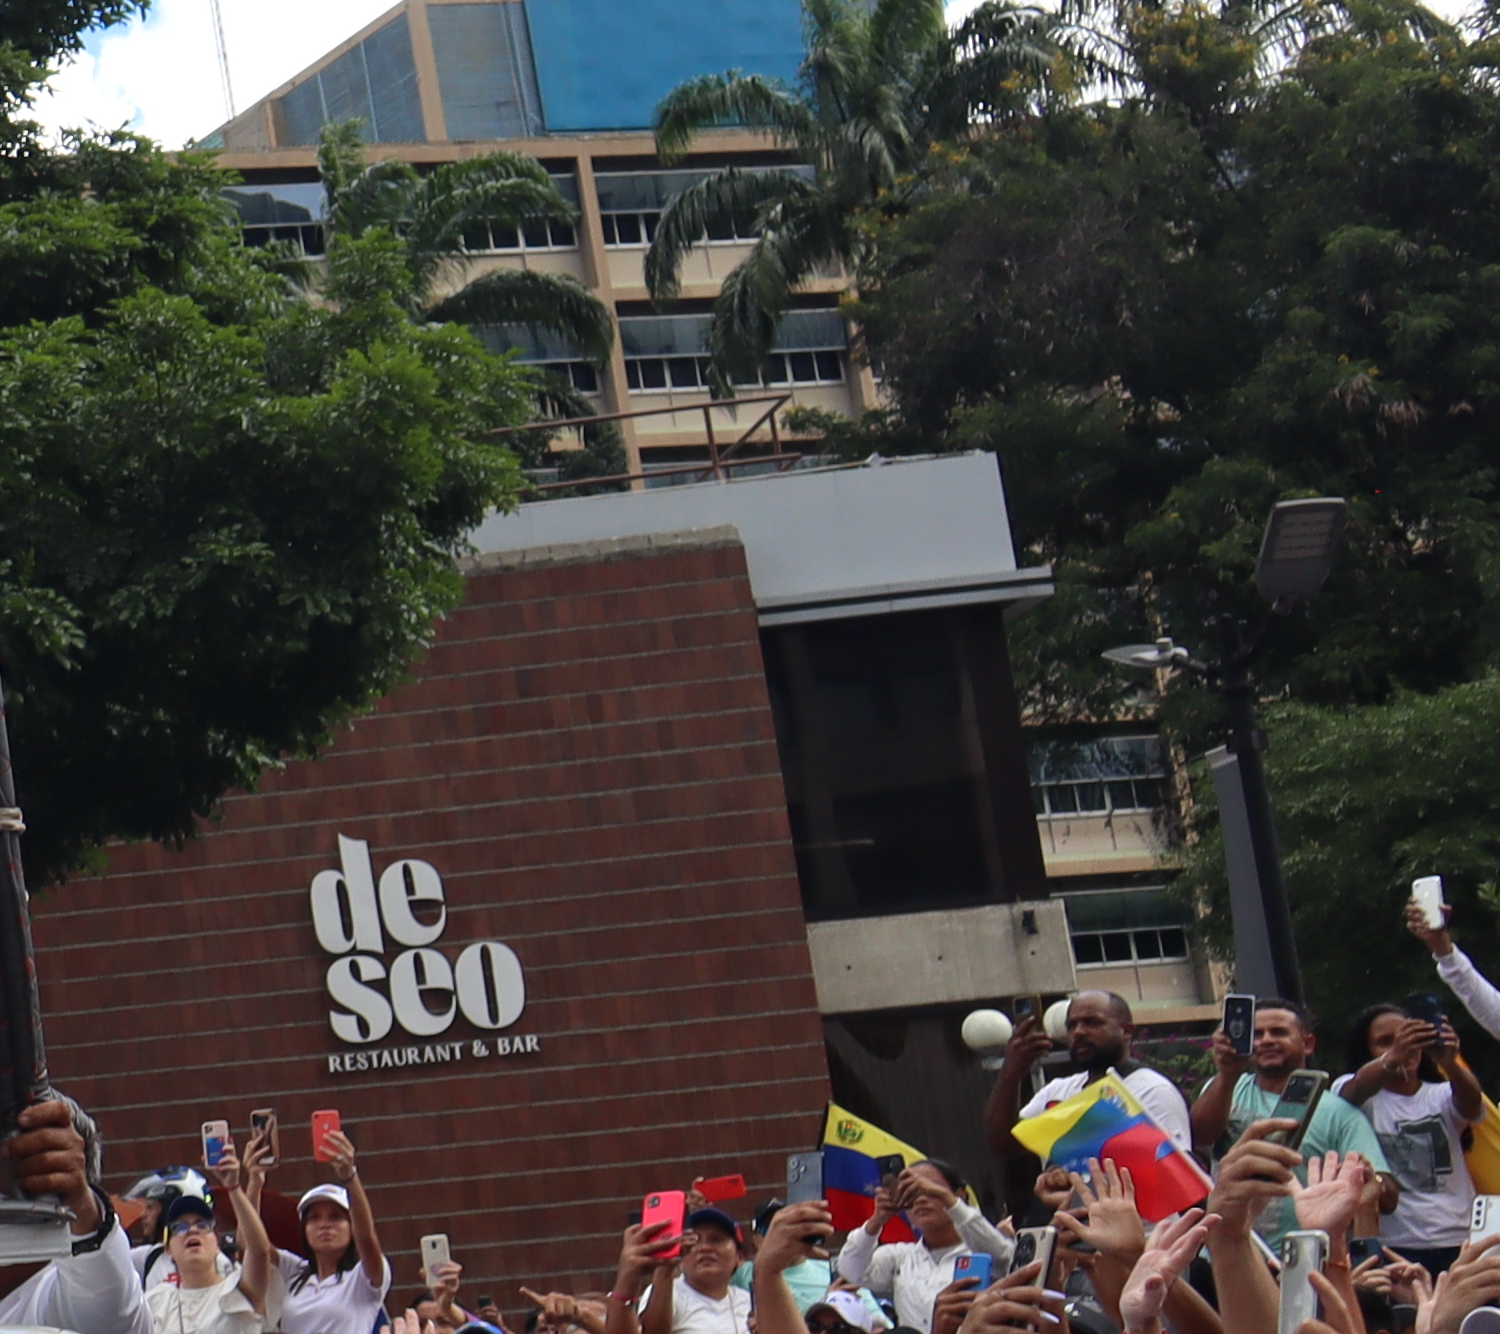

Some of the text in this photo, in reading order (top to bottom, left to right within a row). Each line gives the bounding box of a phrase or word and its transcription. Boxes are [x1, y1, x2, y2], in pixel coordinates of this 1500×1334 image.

[310, 832, 447, 955] de
[326, 940, 526, 1044] seo
[328, 1034, 541, 1073] RESTAURANT & BAR
